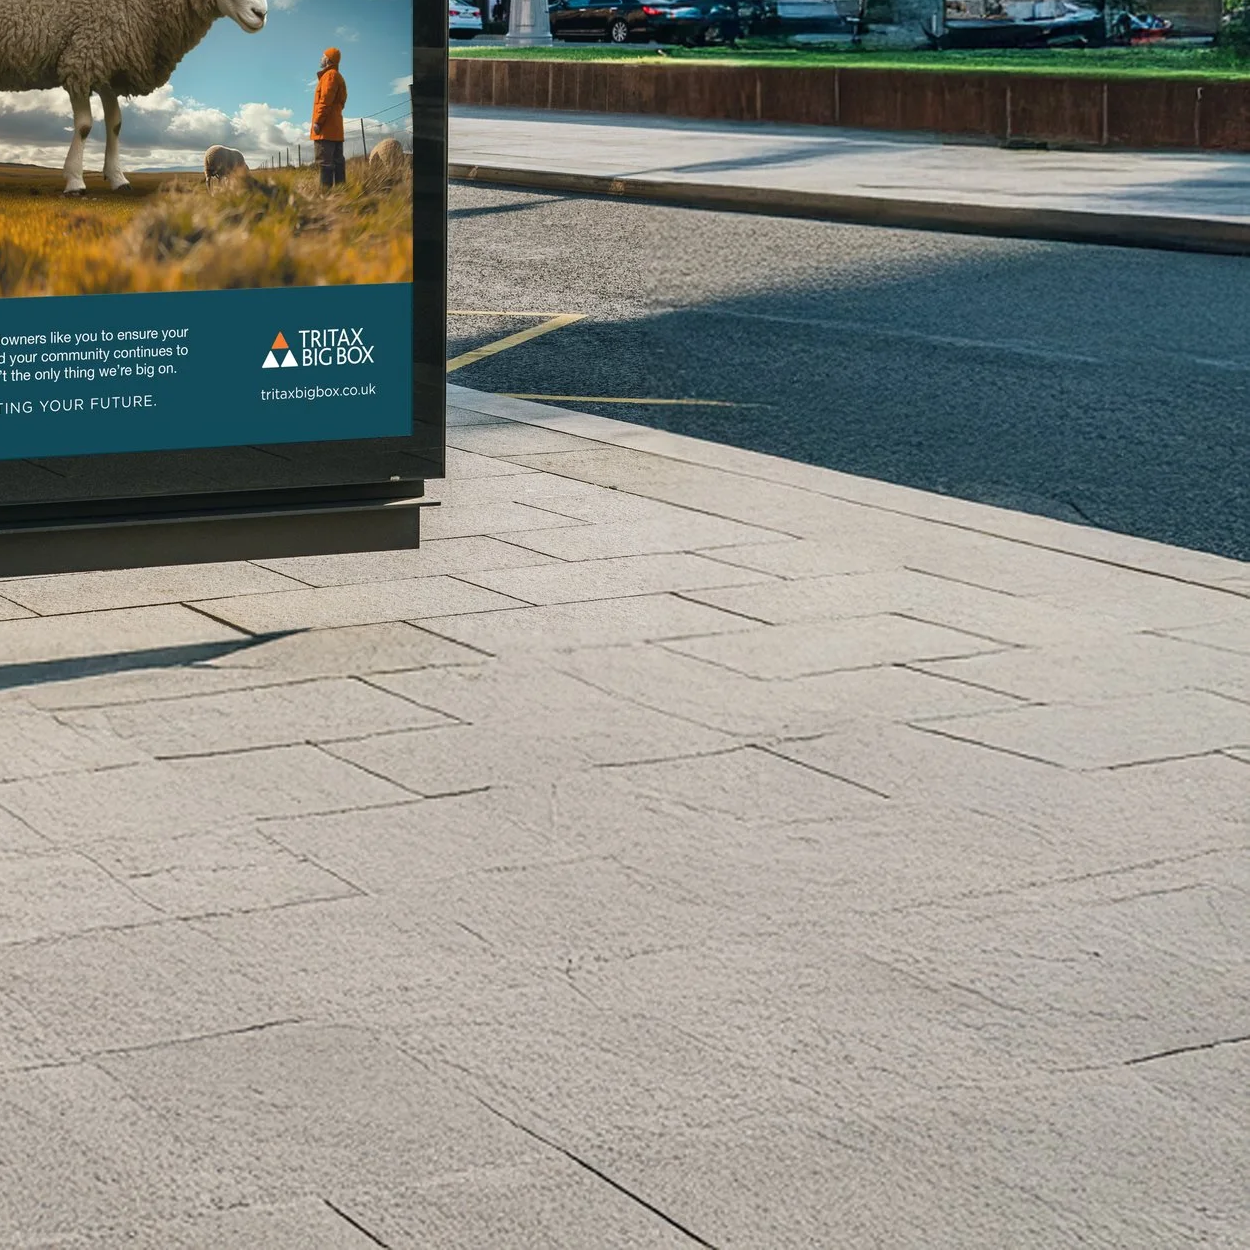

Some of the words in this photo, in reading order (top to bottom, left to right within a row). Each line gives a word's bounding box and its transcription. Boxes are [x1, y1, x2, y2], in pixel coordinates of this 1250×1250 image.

[51, 332, 71, 343] like
[75, 333, 97, 345] you
[101, 330, 113, 341] to
[118, 330, 158, 340] ensure
[162, 329, 188, 341] your
[299, 328, 363, 348] TRITAX
[10, 354, 37, 366] your
[42, 348, 109, 362] community
[114, 346, 172, 358] continues
[177, 345, 188, 355] to
[303, 348, 332, 366] BIG
[337, 346, 374, 364] BOX
[11, 370, 30, 381] the
[35, 368, 60, 382] only
[65, 367, 94, 380] thing
[137, 363, 154, 377] big
[159, 365, 176, 374] on.
[261, 383, 375, 400] tritaxbigbox.co.uk
[40, 399, 83, 411] YOUR
[91, 395, 156, 409] FUTURE.
